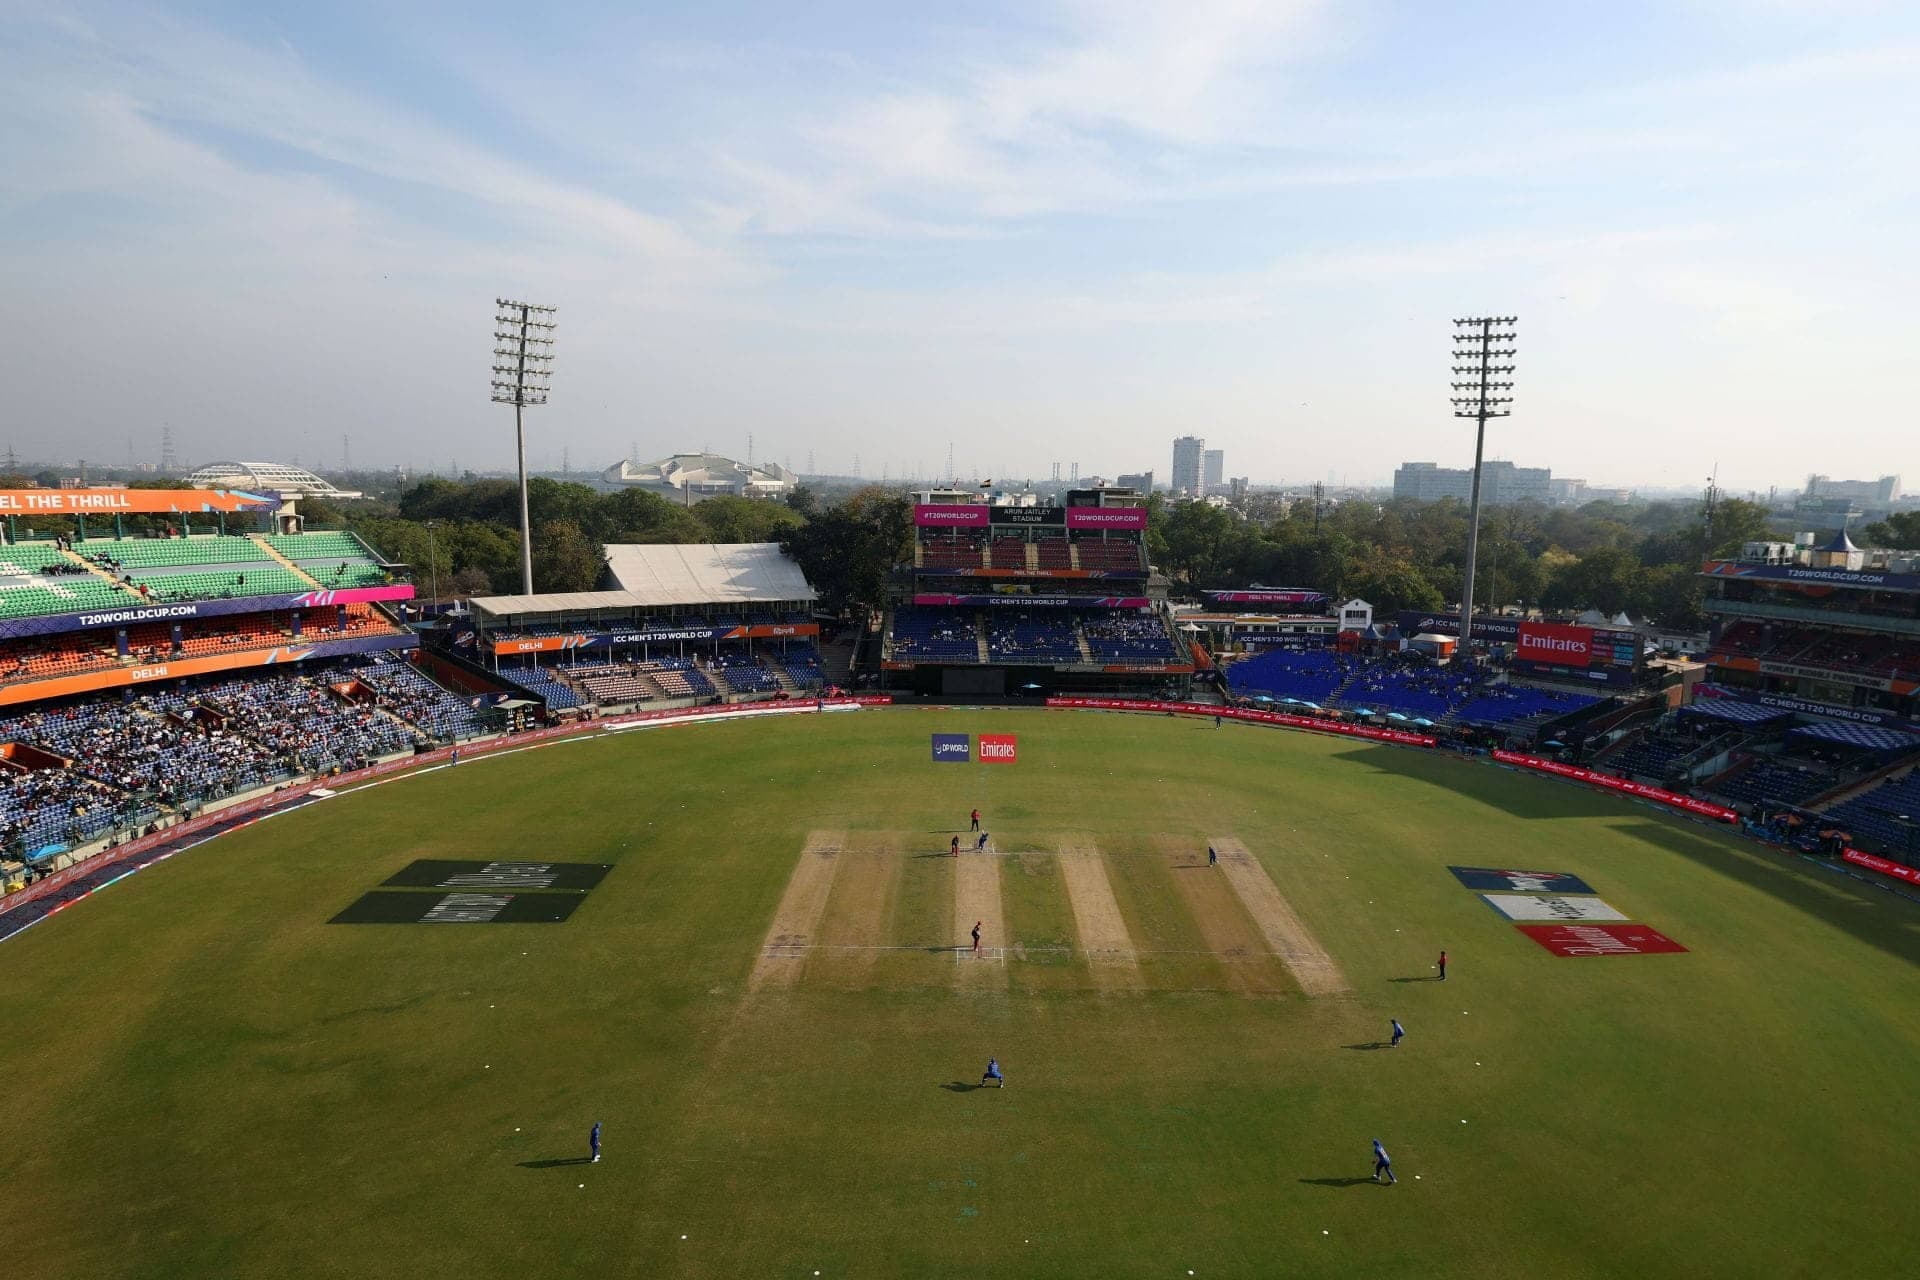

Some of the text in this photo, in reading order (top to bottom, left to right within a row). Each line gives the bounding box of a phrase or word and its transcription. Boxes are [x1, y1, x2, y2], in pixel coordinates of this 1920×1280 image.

[25, 495, 63, 509] THE
[67, 494, 131, 508] THRILL
[1788, 569, 1884, 583] T20WORLDCUP.COM
[79, 605, 197, 625] T20WORLDCUP.COM
[1488, 624, 1515, 633] WORLD
[628, 634, 652, 642] MEN'S
[1522, 633, 1586, 653] Emirates
[519, 642, 543, 650] DELHI
[132, 666, 168, 680] DELHI
[1760, 697, 1882, 723] ICC MEN'S T20 WORLD CUP
[942, 744, 968, 752] DP WORLD
[980, 741, 1015, 757] Emirates
